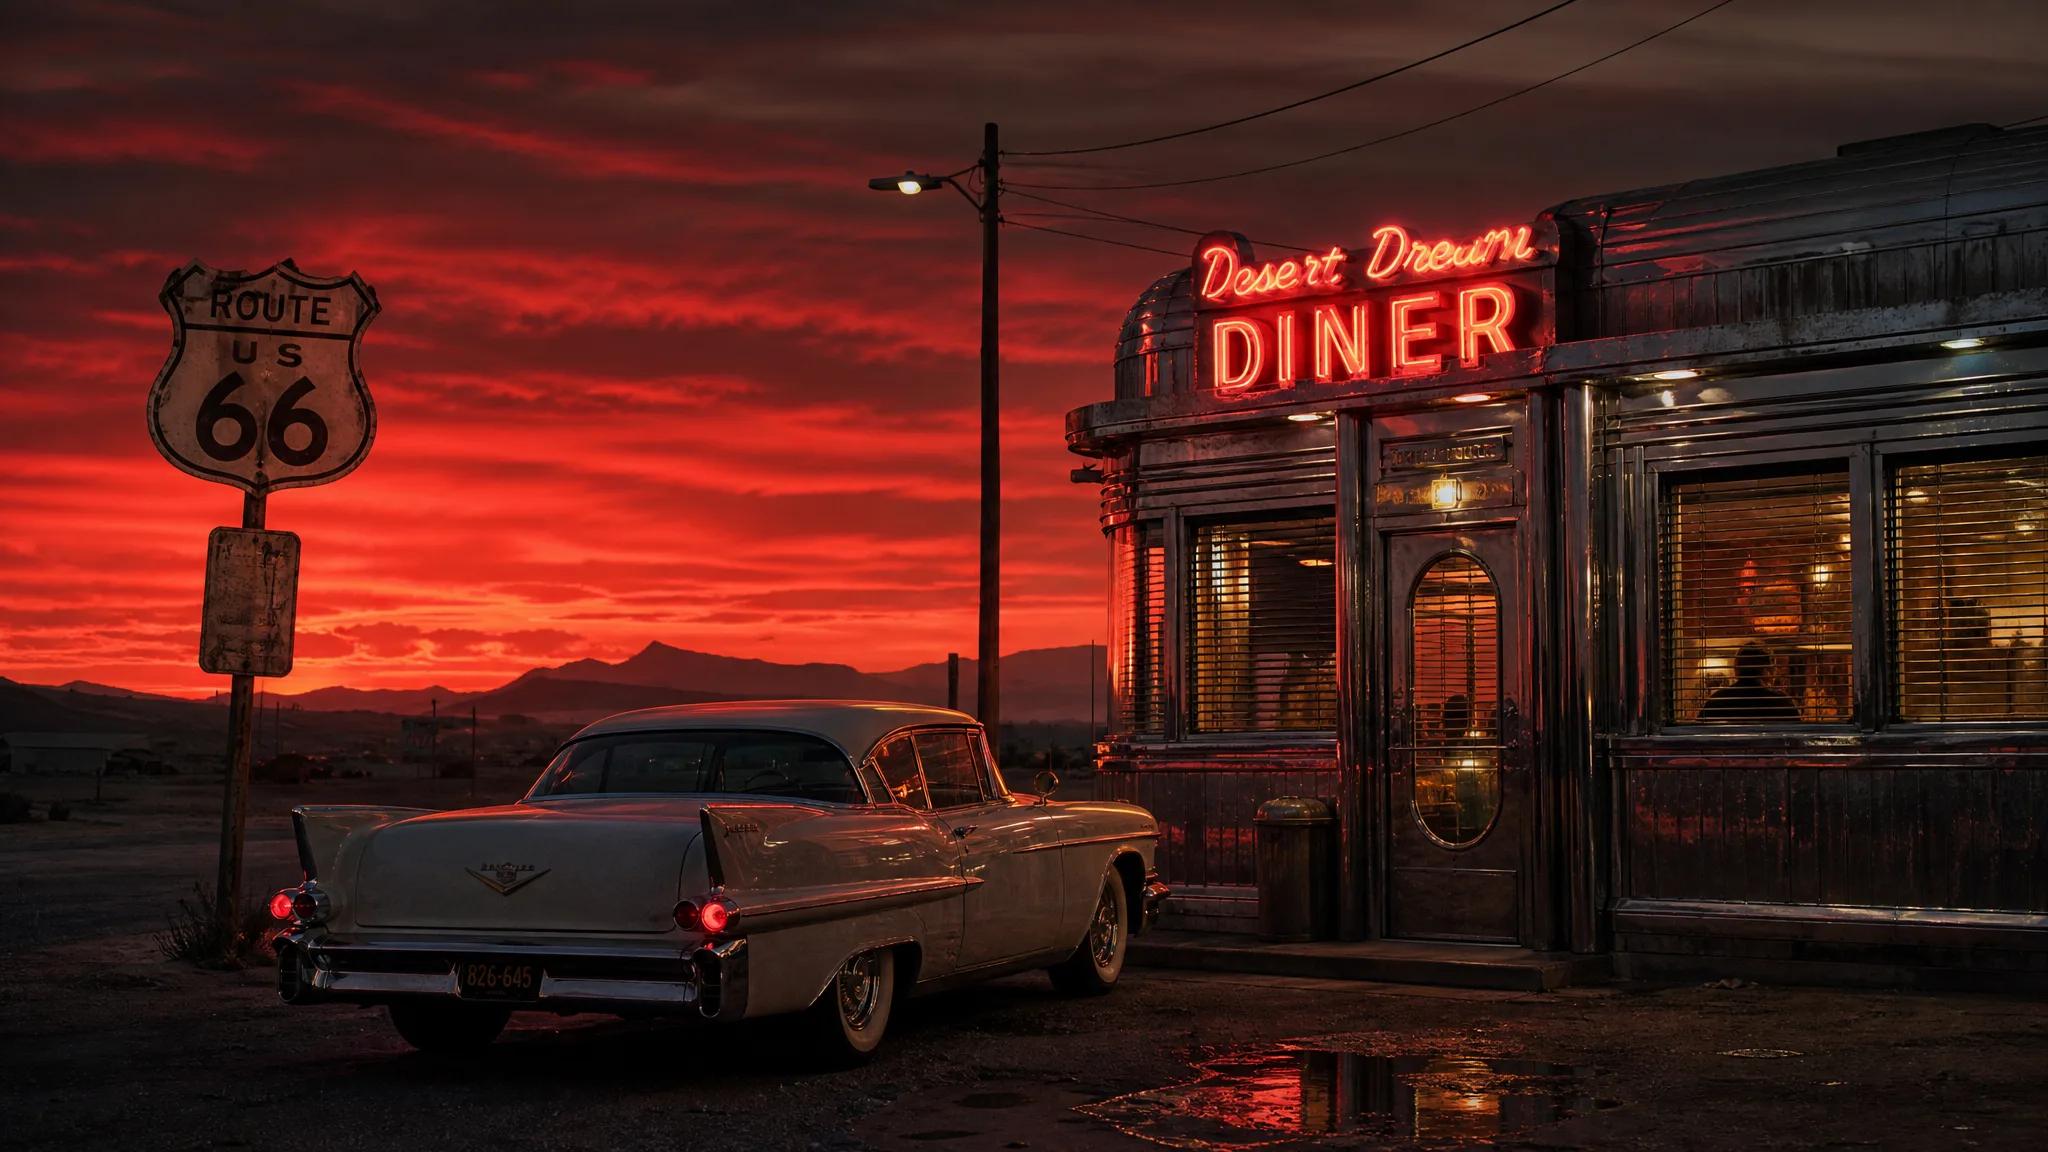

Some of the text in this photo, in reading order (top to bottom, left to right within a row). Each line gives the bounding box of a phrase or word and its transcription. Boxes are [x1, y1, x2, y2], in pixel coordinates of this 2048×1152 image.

[1201, 246, 1347, 299] Desert
[210, 288, 332, 326] ROUTE
[1212, 282, 1516, 399] DINER
[195, 371, 329, 467] 66
[466, 963, 534, 989] 826-645
